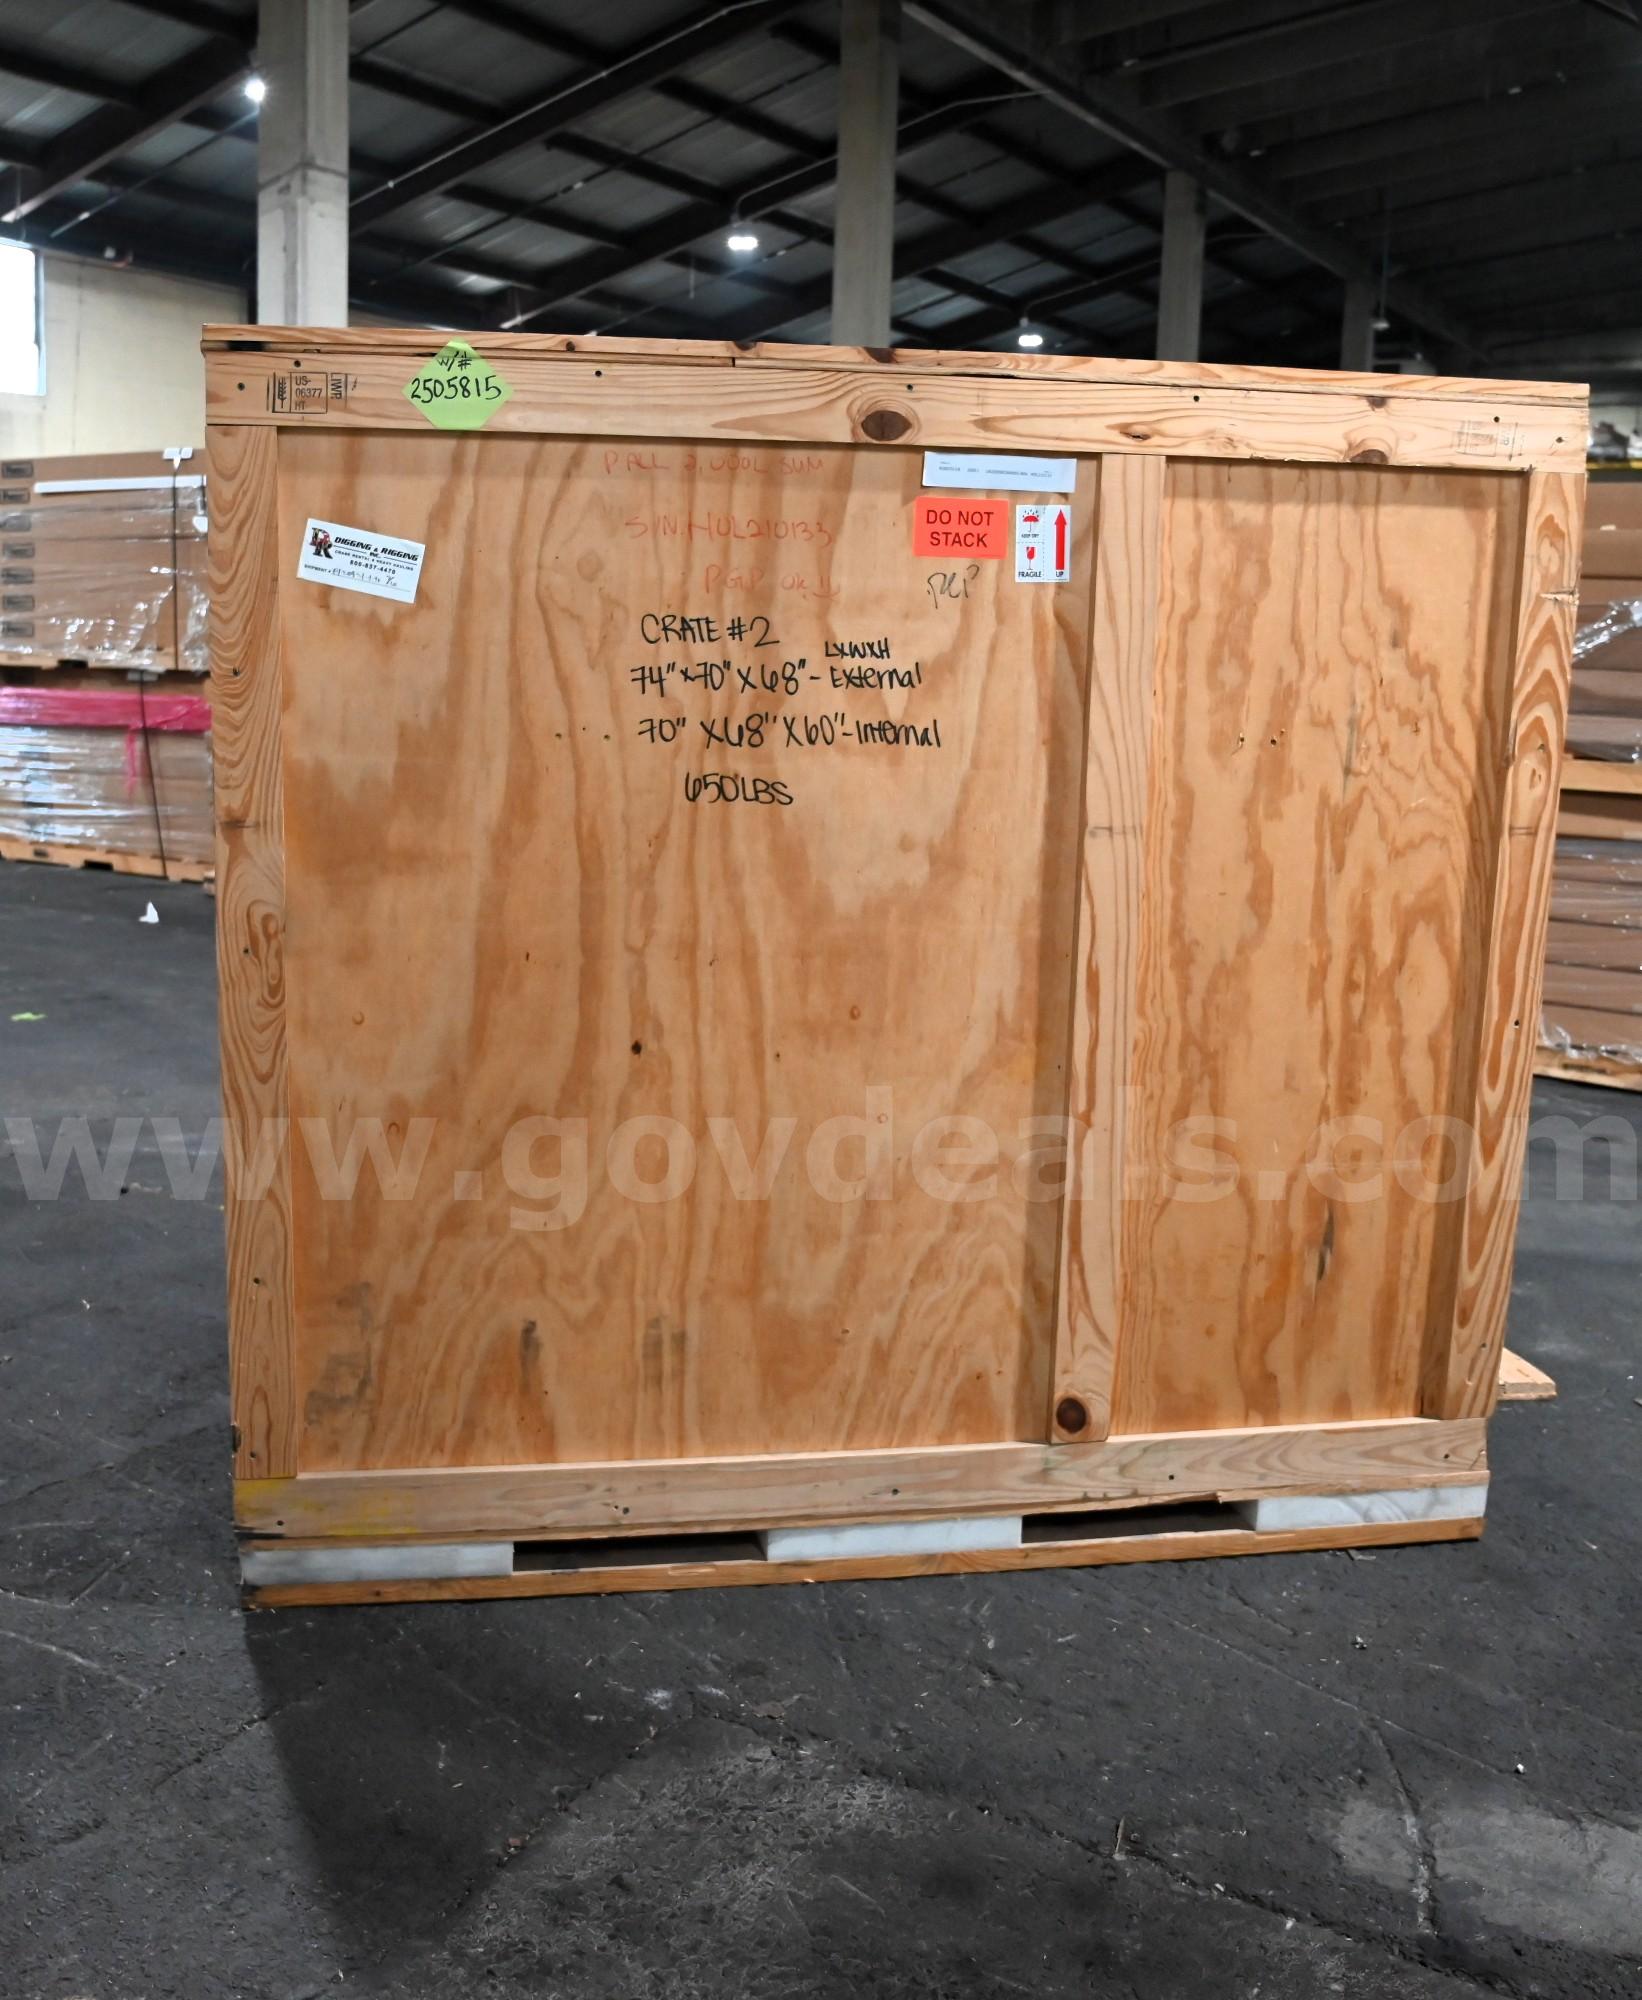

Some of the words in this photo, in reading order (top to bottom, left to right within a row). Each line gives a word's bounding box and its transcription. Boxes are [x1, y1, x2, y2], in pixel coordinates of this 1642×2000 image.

[295, 388, 322, 398] 06377
[411, 375, 502, 403] 2505815
[926, 510, 951, 525] DO
[958, 511, 994, 526] NOT
[334, 537, 372, 550] DIGGING
[381, 548, 418, 561] RIGGING
[930, 531, 988, 548] STACK
[641, 614, 721, 643] CRATE
[726, 616, 780, 648] #2
[829, 662, 922, 689] External
